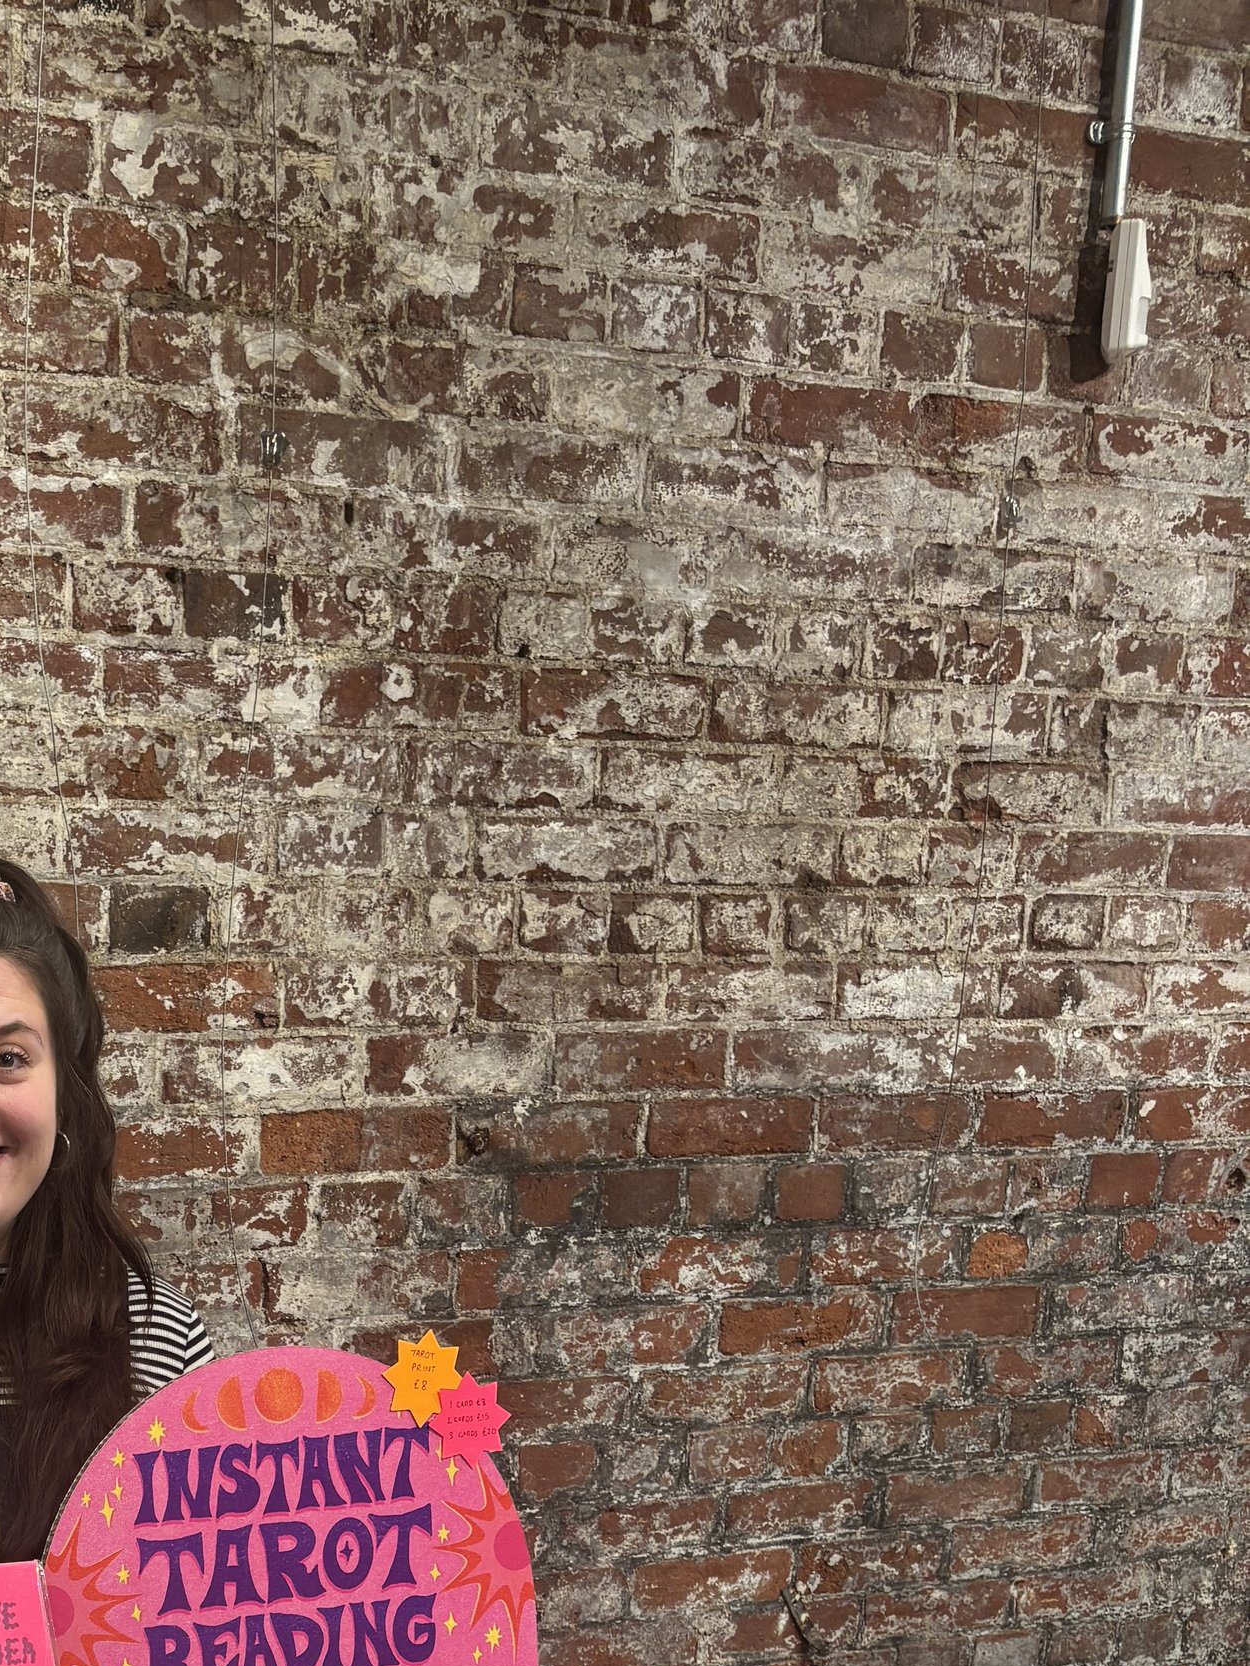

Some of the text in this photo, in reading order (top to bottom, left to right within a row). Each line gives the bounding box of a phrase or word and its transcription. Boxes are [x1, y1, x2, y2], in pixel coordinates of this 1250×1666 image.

[411, 1350, 435, 1360] TAROT
[412, 1363, 436, 1373] PRINT
[414, 1379, 428, 1391] £8
[133, 1424, 430, 1525] INSTANT
[137, 1503, 432, 1616] TAROT
